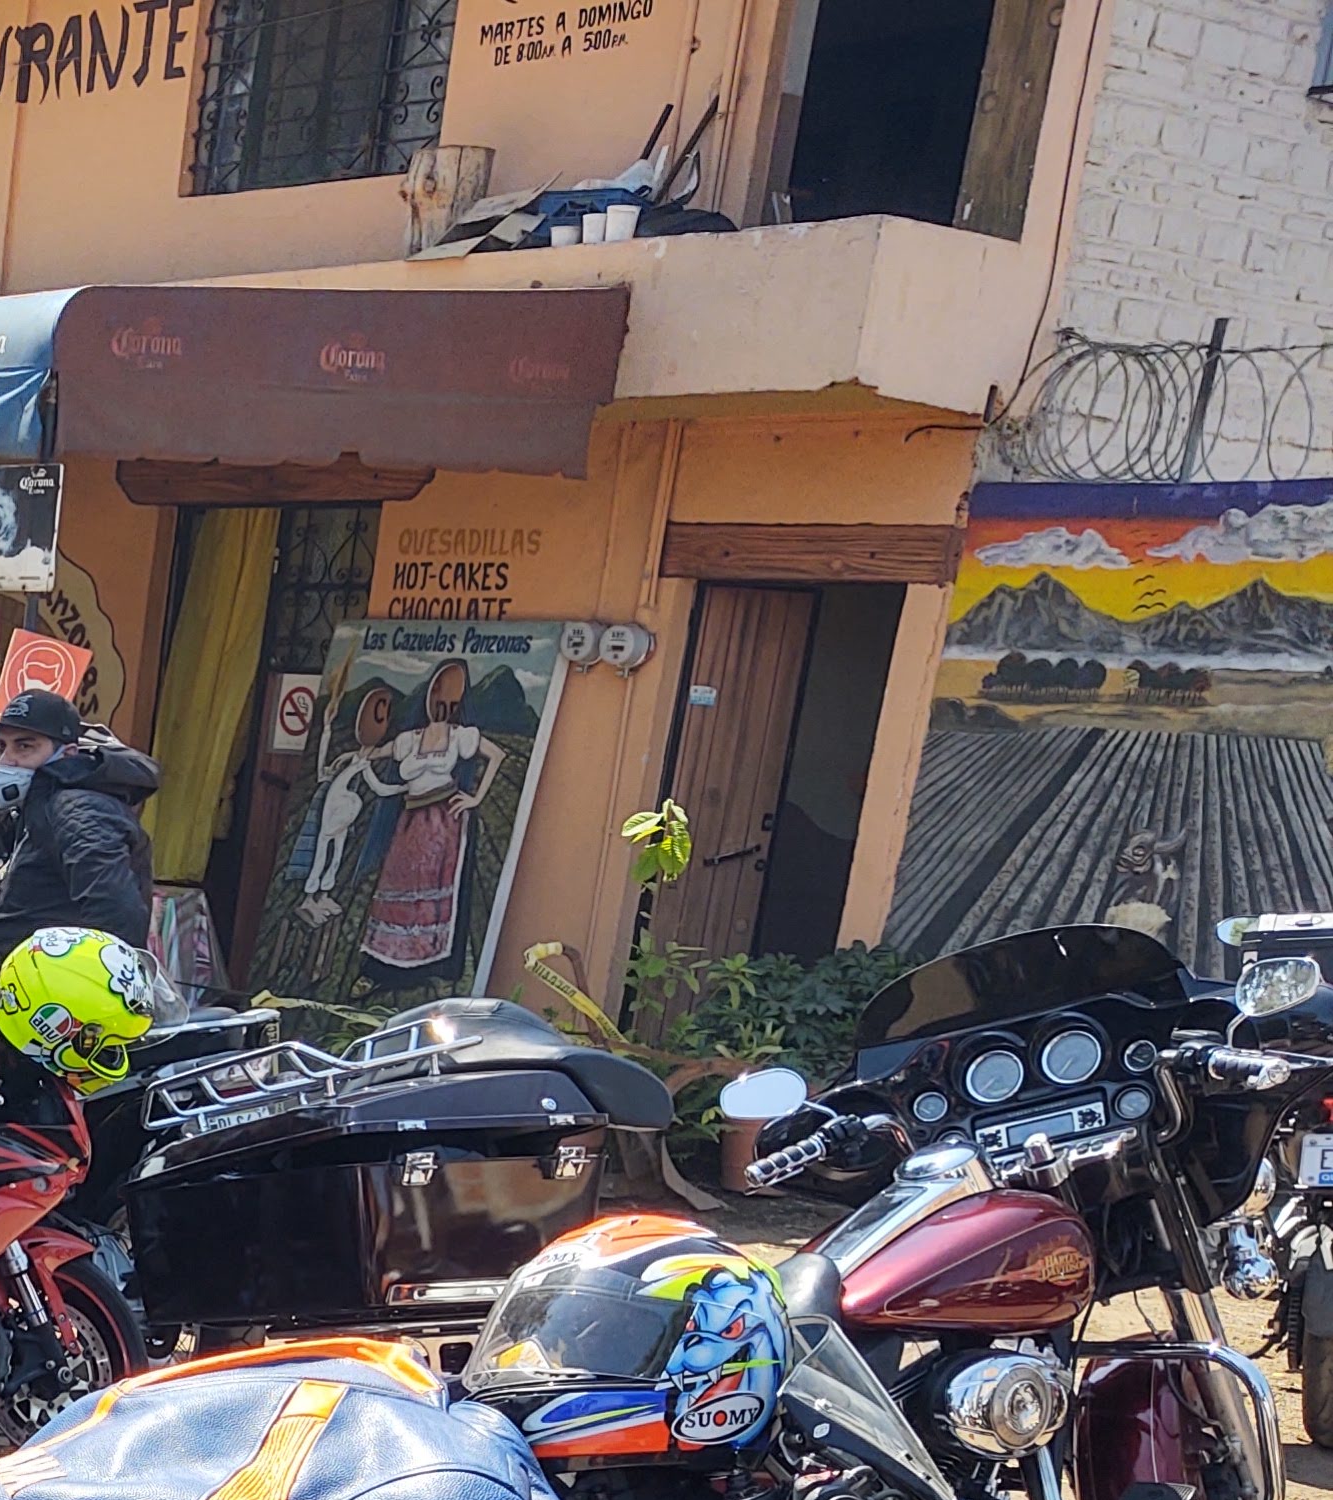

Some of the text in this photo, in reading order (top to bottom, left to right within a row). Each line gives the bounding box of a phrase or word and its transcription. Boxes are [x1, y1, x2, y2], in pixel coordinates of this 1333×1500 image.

[480, 0, 653, 46] MARTES A DOMINGO
[494, 36, 572, 66] DE A
[111, 327, 182, 360] Corona
[320, 341, 386, 374] Corona
[398, 528, 543, 557] QUESADILLAS
[393, 562, 510, 592] HOT-CAKES
[388, 597, 513, 621] CHOCOLATE
[363, 624, 534, 655] Las Cazuelas Panzonas
[684, 1407, 759, 1429] SUOMY
